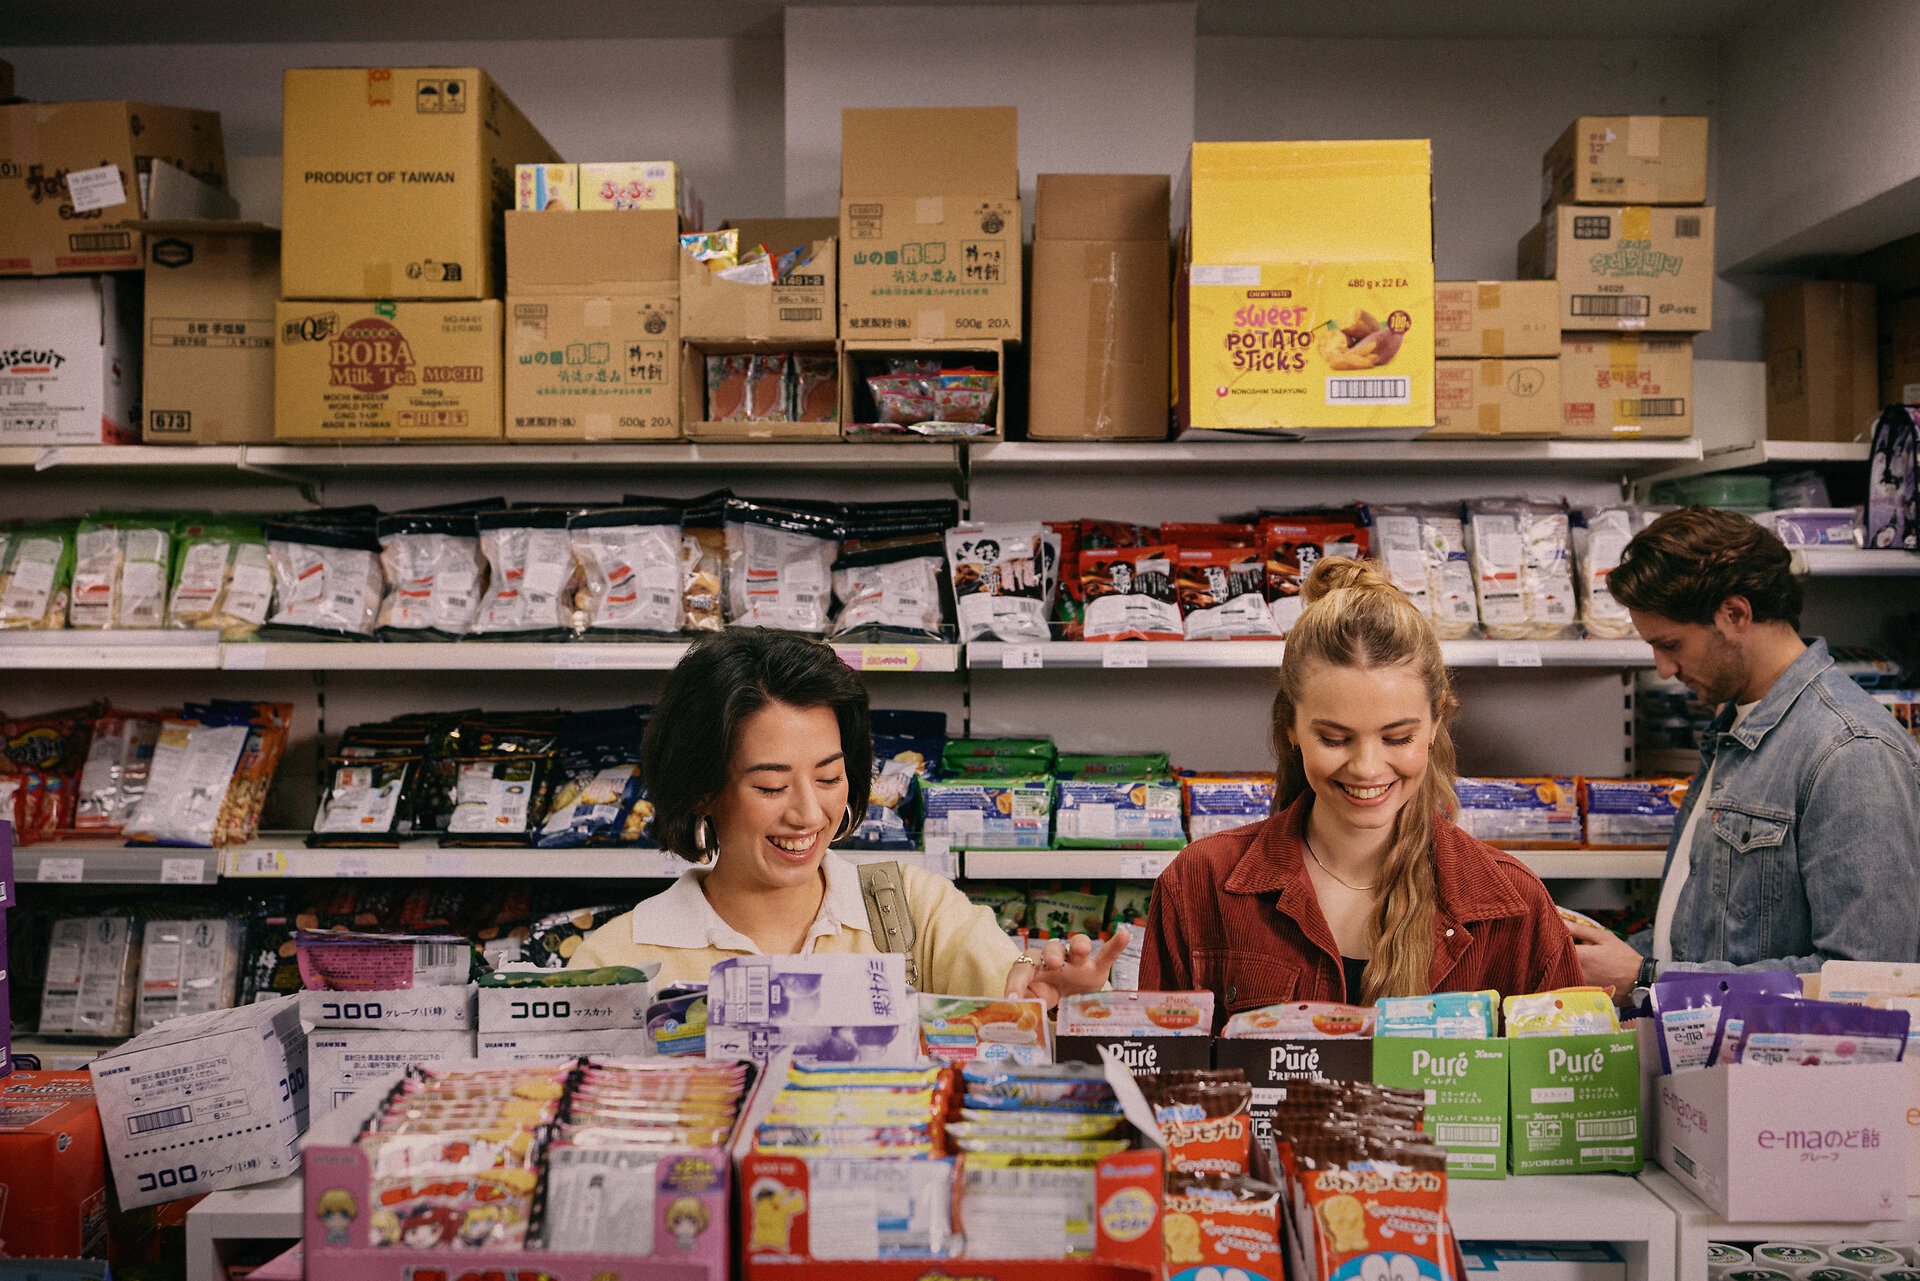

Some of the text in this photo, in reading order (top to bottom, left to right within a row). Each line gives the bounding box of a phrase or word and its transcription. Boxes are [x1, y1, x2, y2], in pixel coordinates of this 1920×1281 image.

[304, 171, 456, 184] PRODUCT OF TAIWAN
[1347, 279, 1365, 288] 480
[1366, 280, 1373, 290] g
[1382, 279, 1393, 287] 22
[1395, 279, 1409, 287] EA
[955, 319, 982, 329] 500g
[329, 340, 416, 367] BOBA
[329, 367, 416, 386] Milk Tea
[422, 366, 484, 383] MOCHI
[155, 416, 186, 428] 673
[322, 421, 391, 429] MADE IN TAIWAN
[619, 417, 646, 429] 500g
[322, 1003, 382, 1019] コロロ
[511, 1001, 570, 1019] コロロ
[1674, 1031, 1703, 1042] e-ma
[1475, 1049, 1503, 1060] Kanro
[1609, 1043, 1634, 1053] Kanro
[1270, 1044, 1320, 1070] Puré
[1412, 1049, 1469, 1077] Puré
[1548, 1047, 1605, 1075] Puré
[1758, 1128, 1880, 1150] e-maのど飴
[137, 1164, 198, 1192] コロロ
